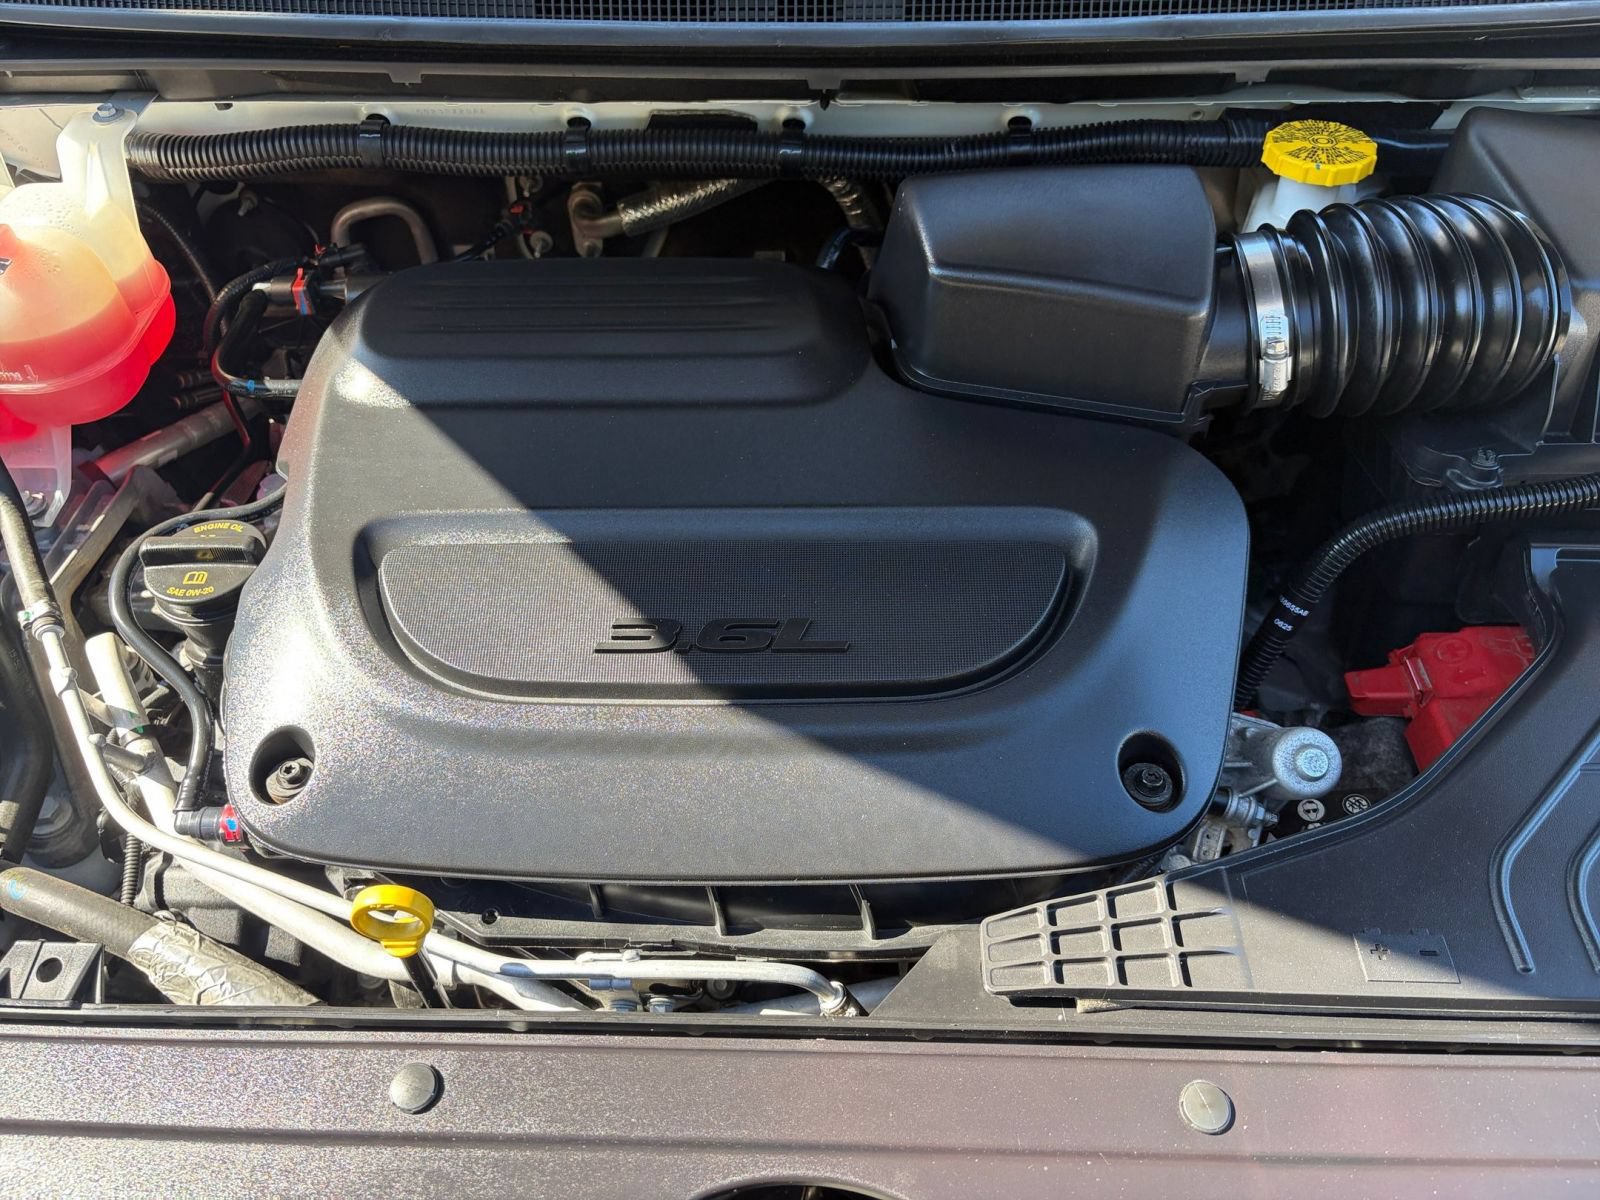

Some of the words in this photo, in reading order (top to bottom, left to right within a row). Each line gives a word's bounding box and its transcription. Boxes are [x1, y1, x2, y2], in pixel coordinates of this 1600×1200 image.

[193, 522, 230, 533] ENGINE
[230, 523, 243, 532] OIL
[166, 586, 186, 596] SAE
[186, 585, 214, 596] 0W-20
[594, 617, 850, 654] 3.6L
